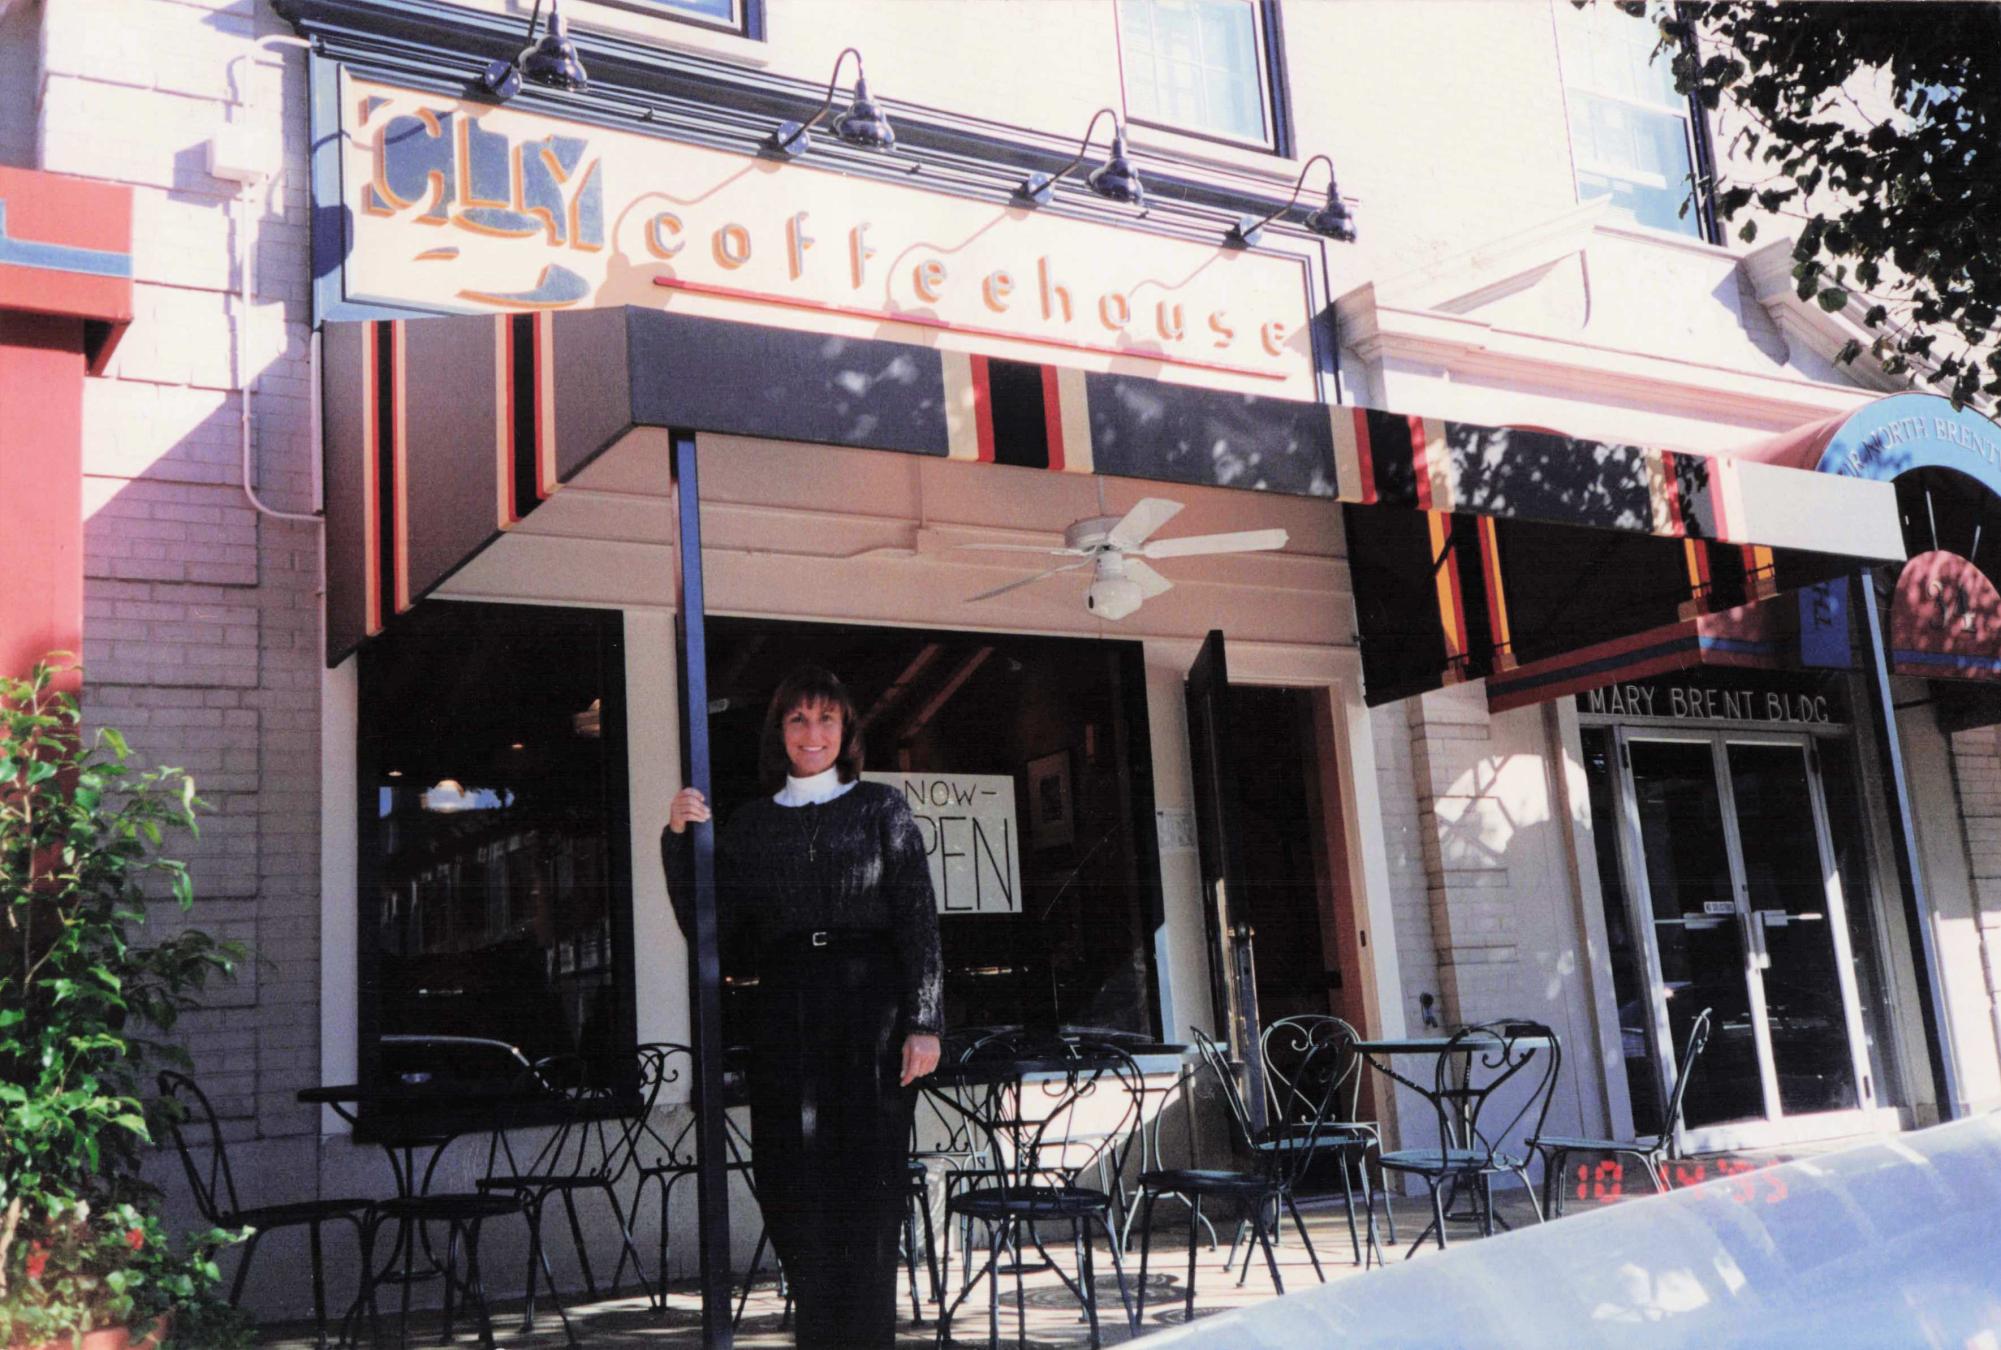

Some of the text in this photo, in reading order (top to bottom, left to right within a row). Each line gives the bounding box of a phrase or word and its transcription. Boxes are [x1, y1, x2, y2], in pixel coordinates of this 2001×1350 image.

[645, 211, 1287, 357] coffeehouse
[1862, 416, 2001, 464] NORTH BRENT
[1588, 684, 1829, 723] MARY BRENT BLDG
[914, 814, 1013, 911] PEN
